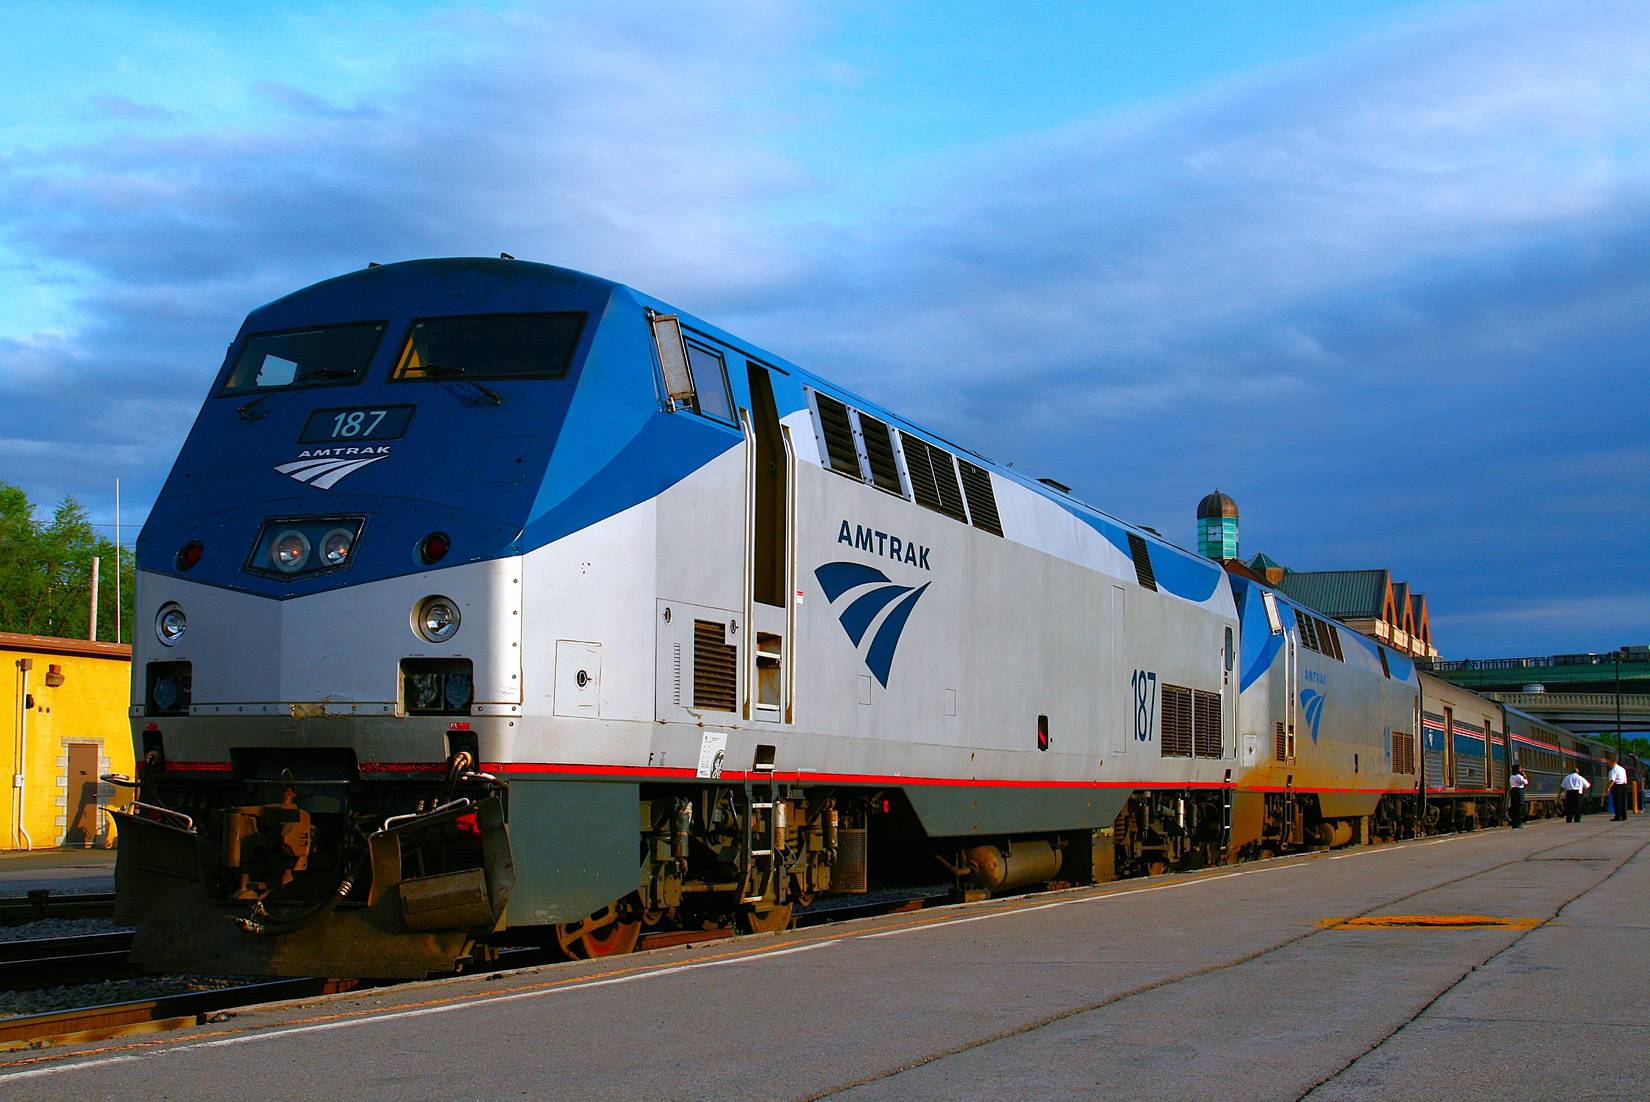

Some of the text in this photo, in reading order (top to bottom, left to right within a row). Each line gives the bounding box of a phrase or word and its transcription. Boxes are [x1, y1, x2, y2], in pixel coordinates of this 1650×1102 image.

[332, 411, 387, 437] 187
[298, 446, 391, 457] AMTRAK
[838, 520, 930, 571] AMTRAK
[1131, 669, 1156, 742] 187
